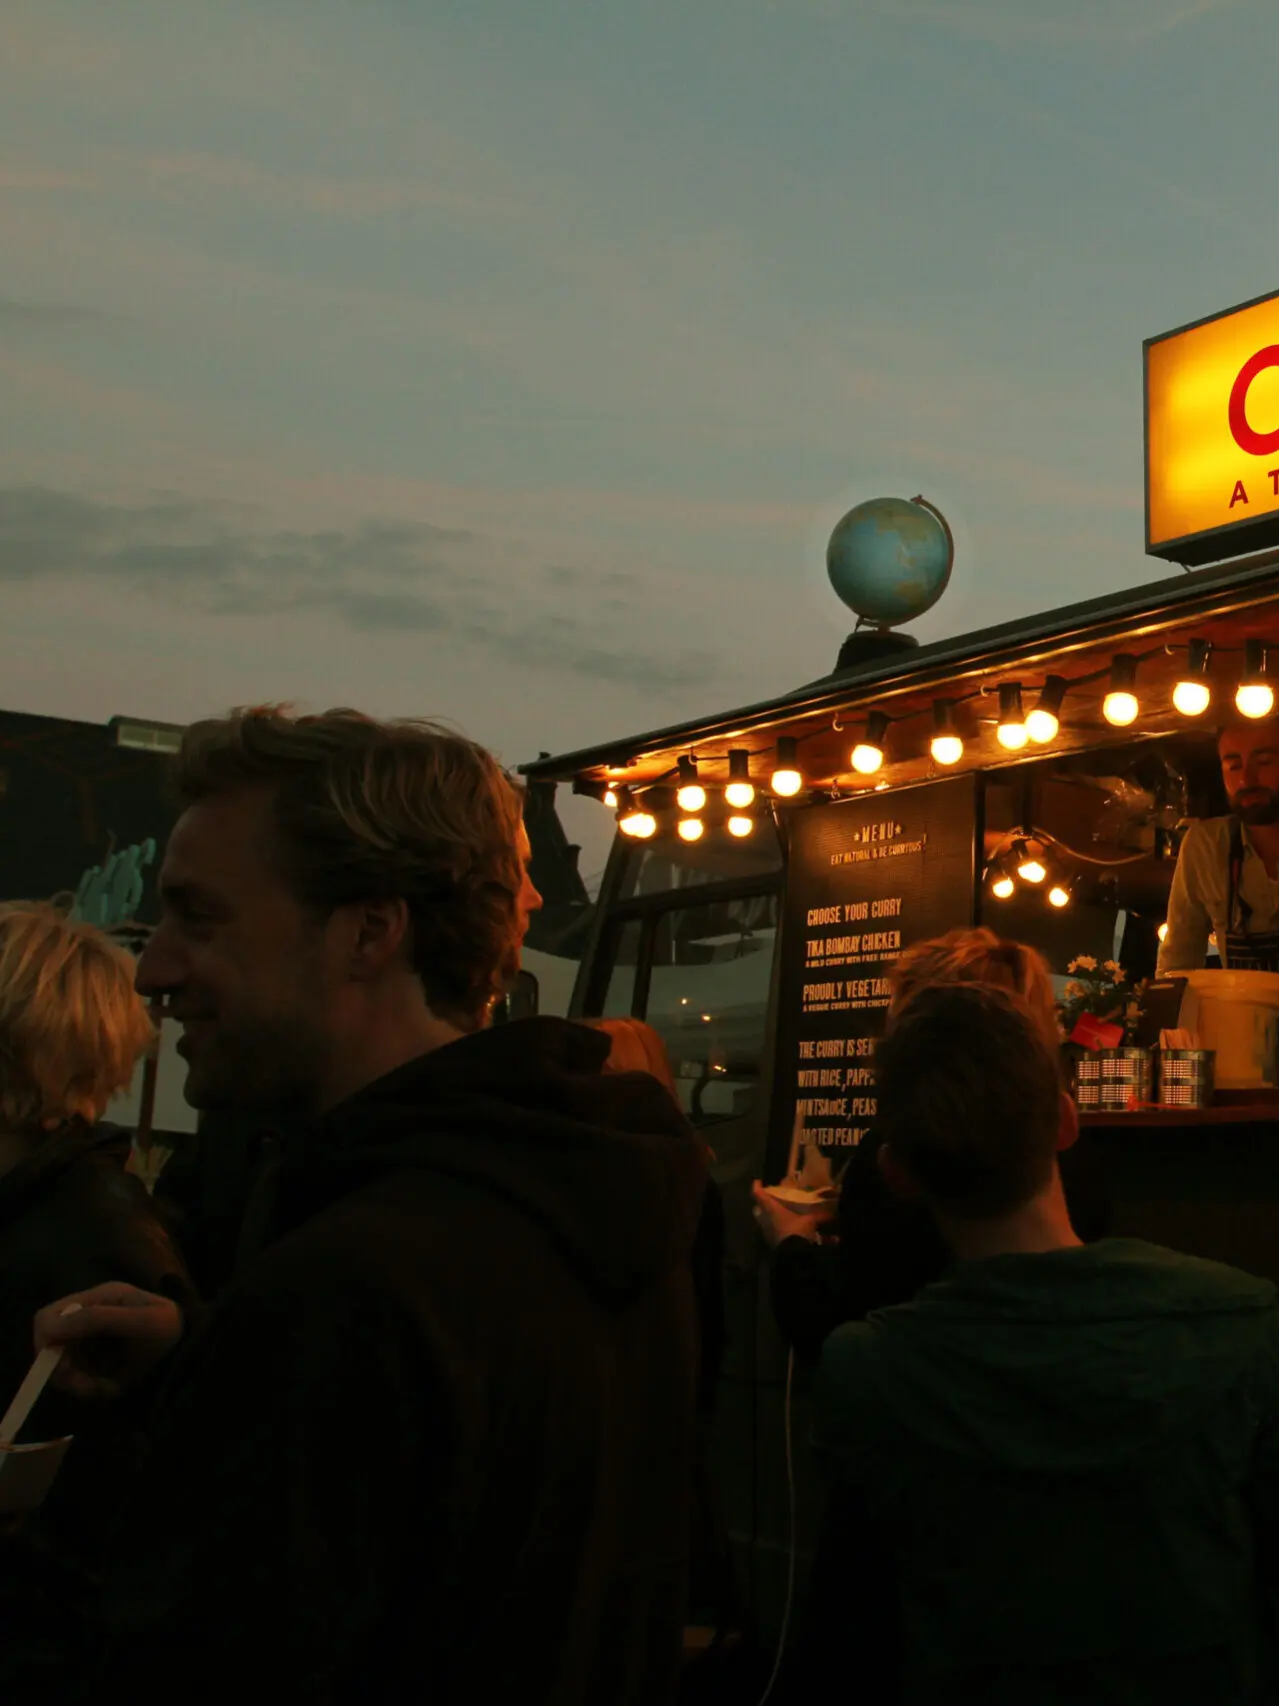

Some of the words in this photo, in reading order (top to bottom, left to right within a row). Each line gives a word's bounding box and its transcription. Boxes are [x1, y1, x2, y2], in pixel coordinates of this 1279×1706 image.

[1228, 480, 1250, 509] A
[861, 821, 894, 843] MENU
[807, 905, 841, 926] CHOOSE
[844, 901, 869, 922] YOUR
[871, 897, 902, 918] CURRY
[825, 935, 861, 956] BOMBAY
[861, 930, 901, 952] CHICKEN
[802, 982, 844, 1002] PROUDLY
[845, 978, 891, 998] VEGETAR
[799, 1041, 816, 1059] THE
[816, 1039, 844, 1058] CURRY
[846, 1039, 855, 1057] IS
[797, 1070, 819, 1088] WITH
